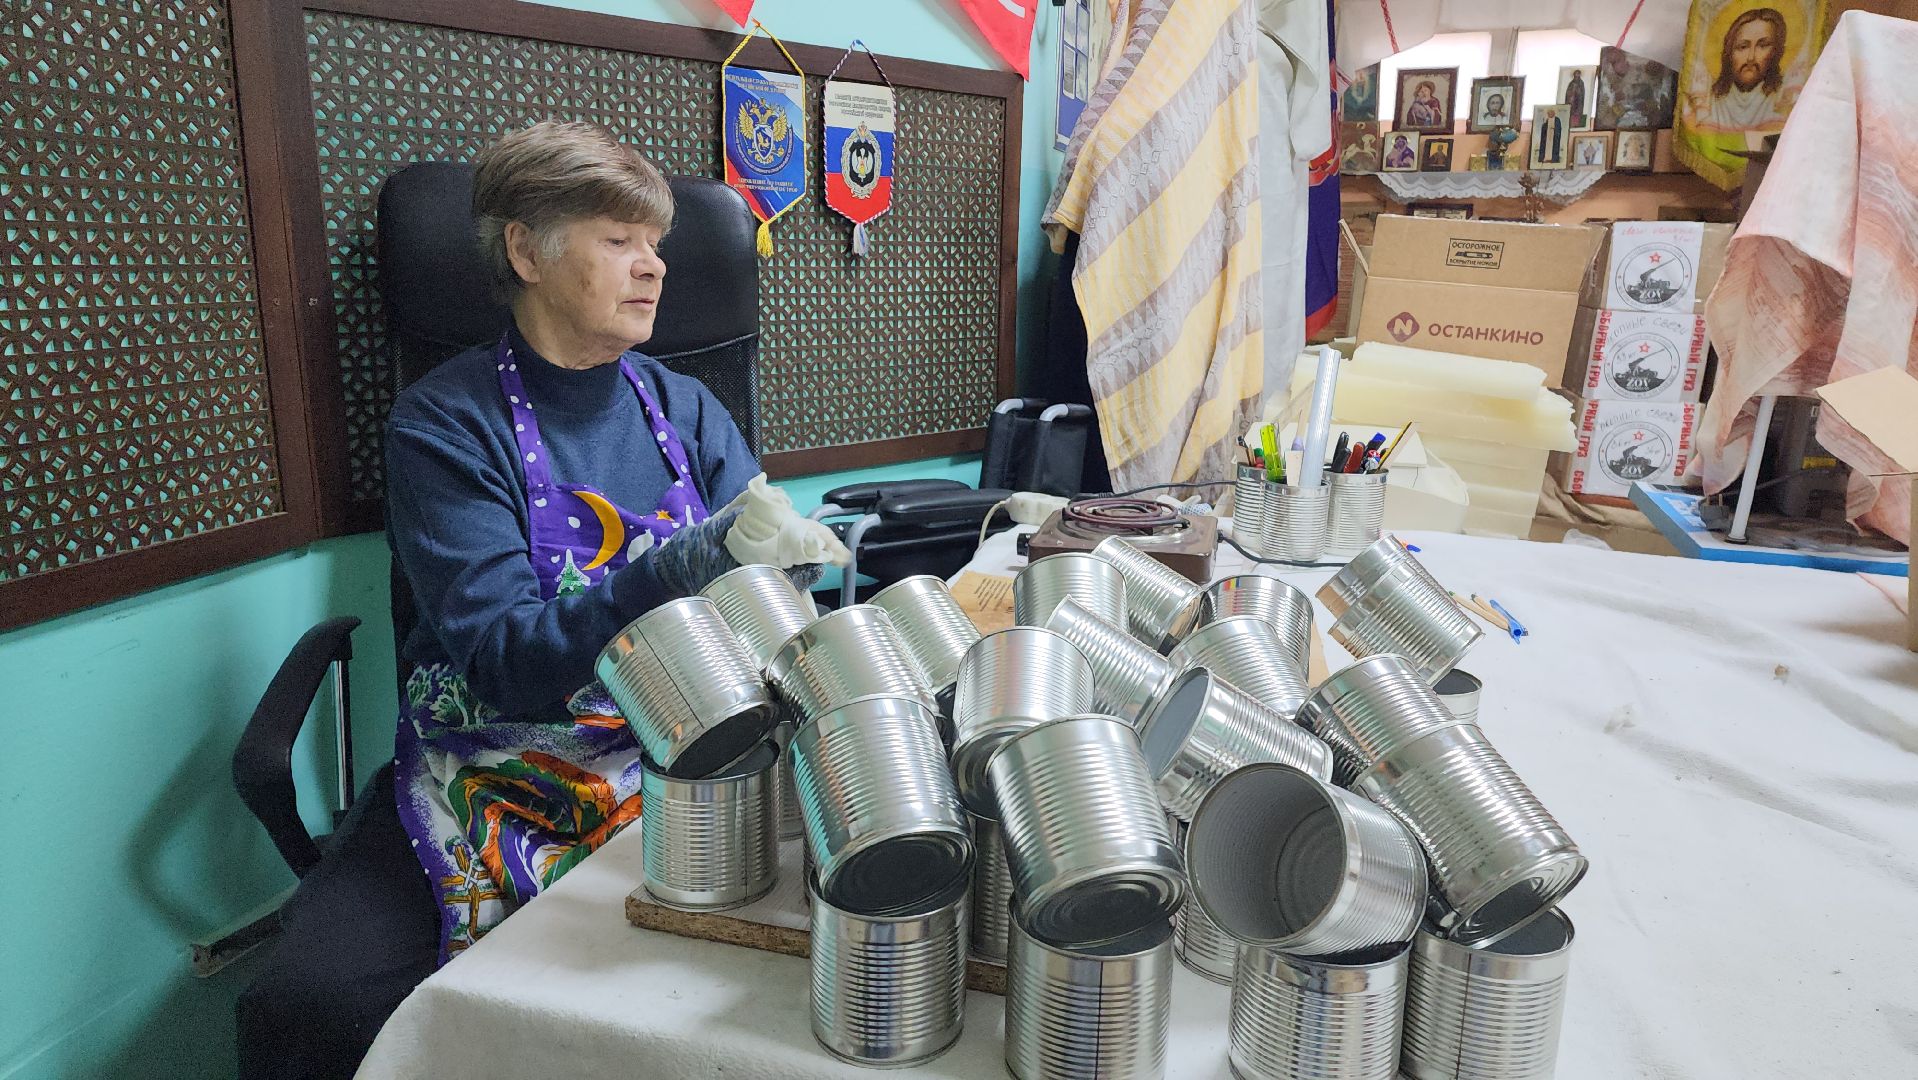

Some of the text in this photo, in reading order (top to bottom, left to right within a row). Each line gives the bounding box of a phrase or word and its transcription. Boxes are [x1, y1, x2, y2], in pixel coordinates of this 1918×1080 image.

[1452, 242, 1500, 251] ОСТОРОЖНОЕ
[1428, 323, 1544, 346] ОСТАНКИНО
[1684, 315, 1706, 391] БОРНЫЙ ГРУЗ
[1587, 365, 1601, 388] ГРУЗ
[1577, 435, 1591, 458] ГРУЗ
[1674, 455, 1687, 476] ГРУЗ
